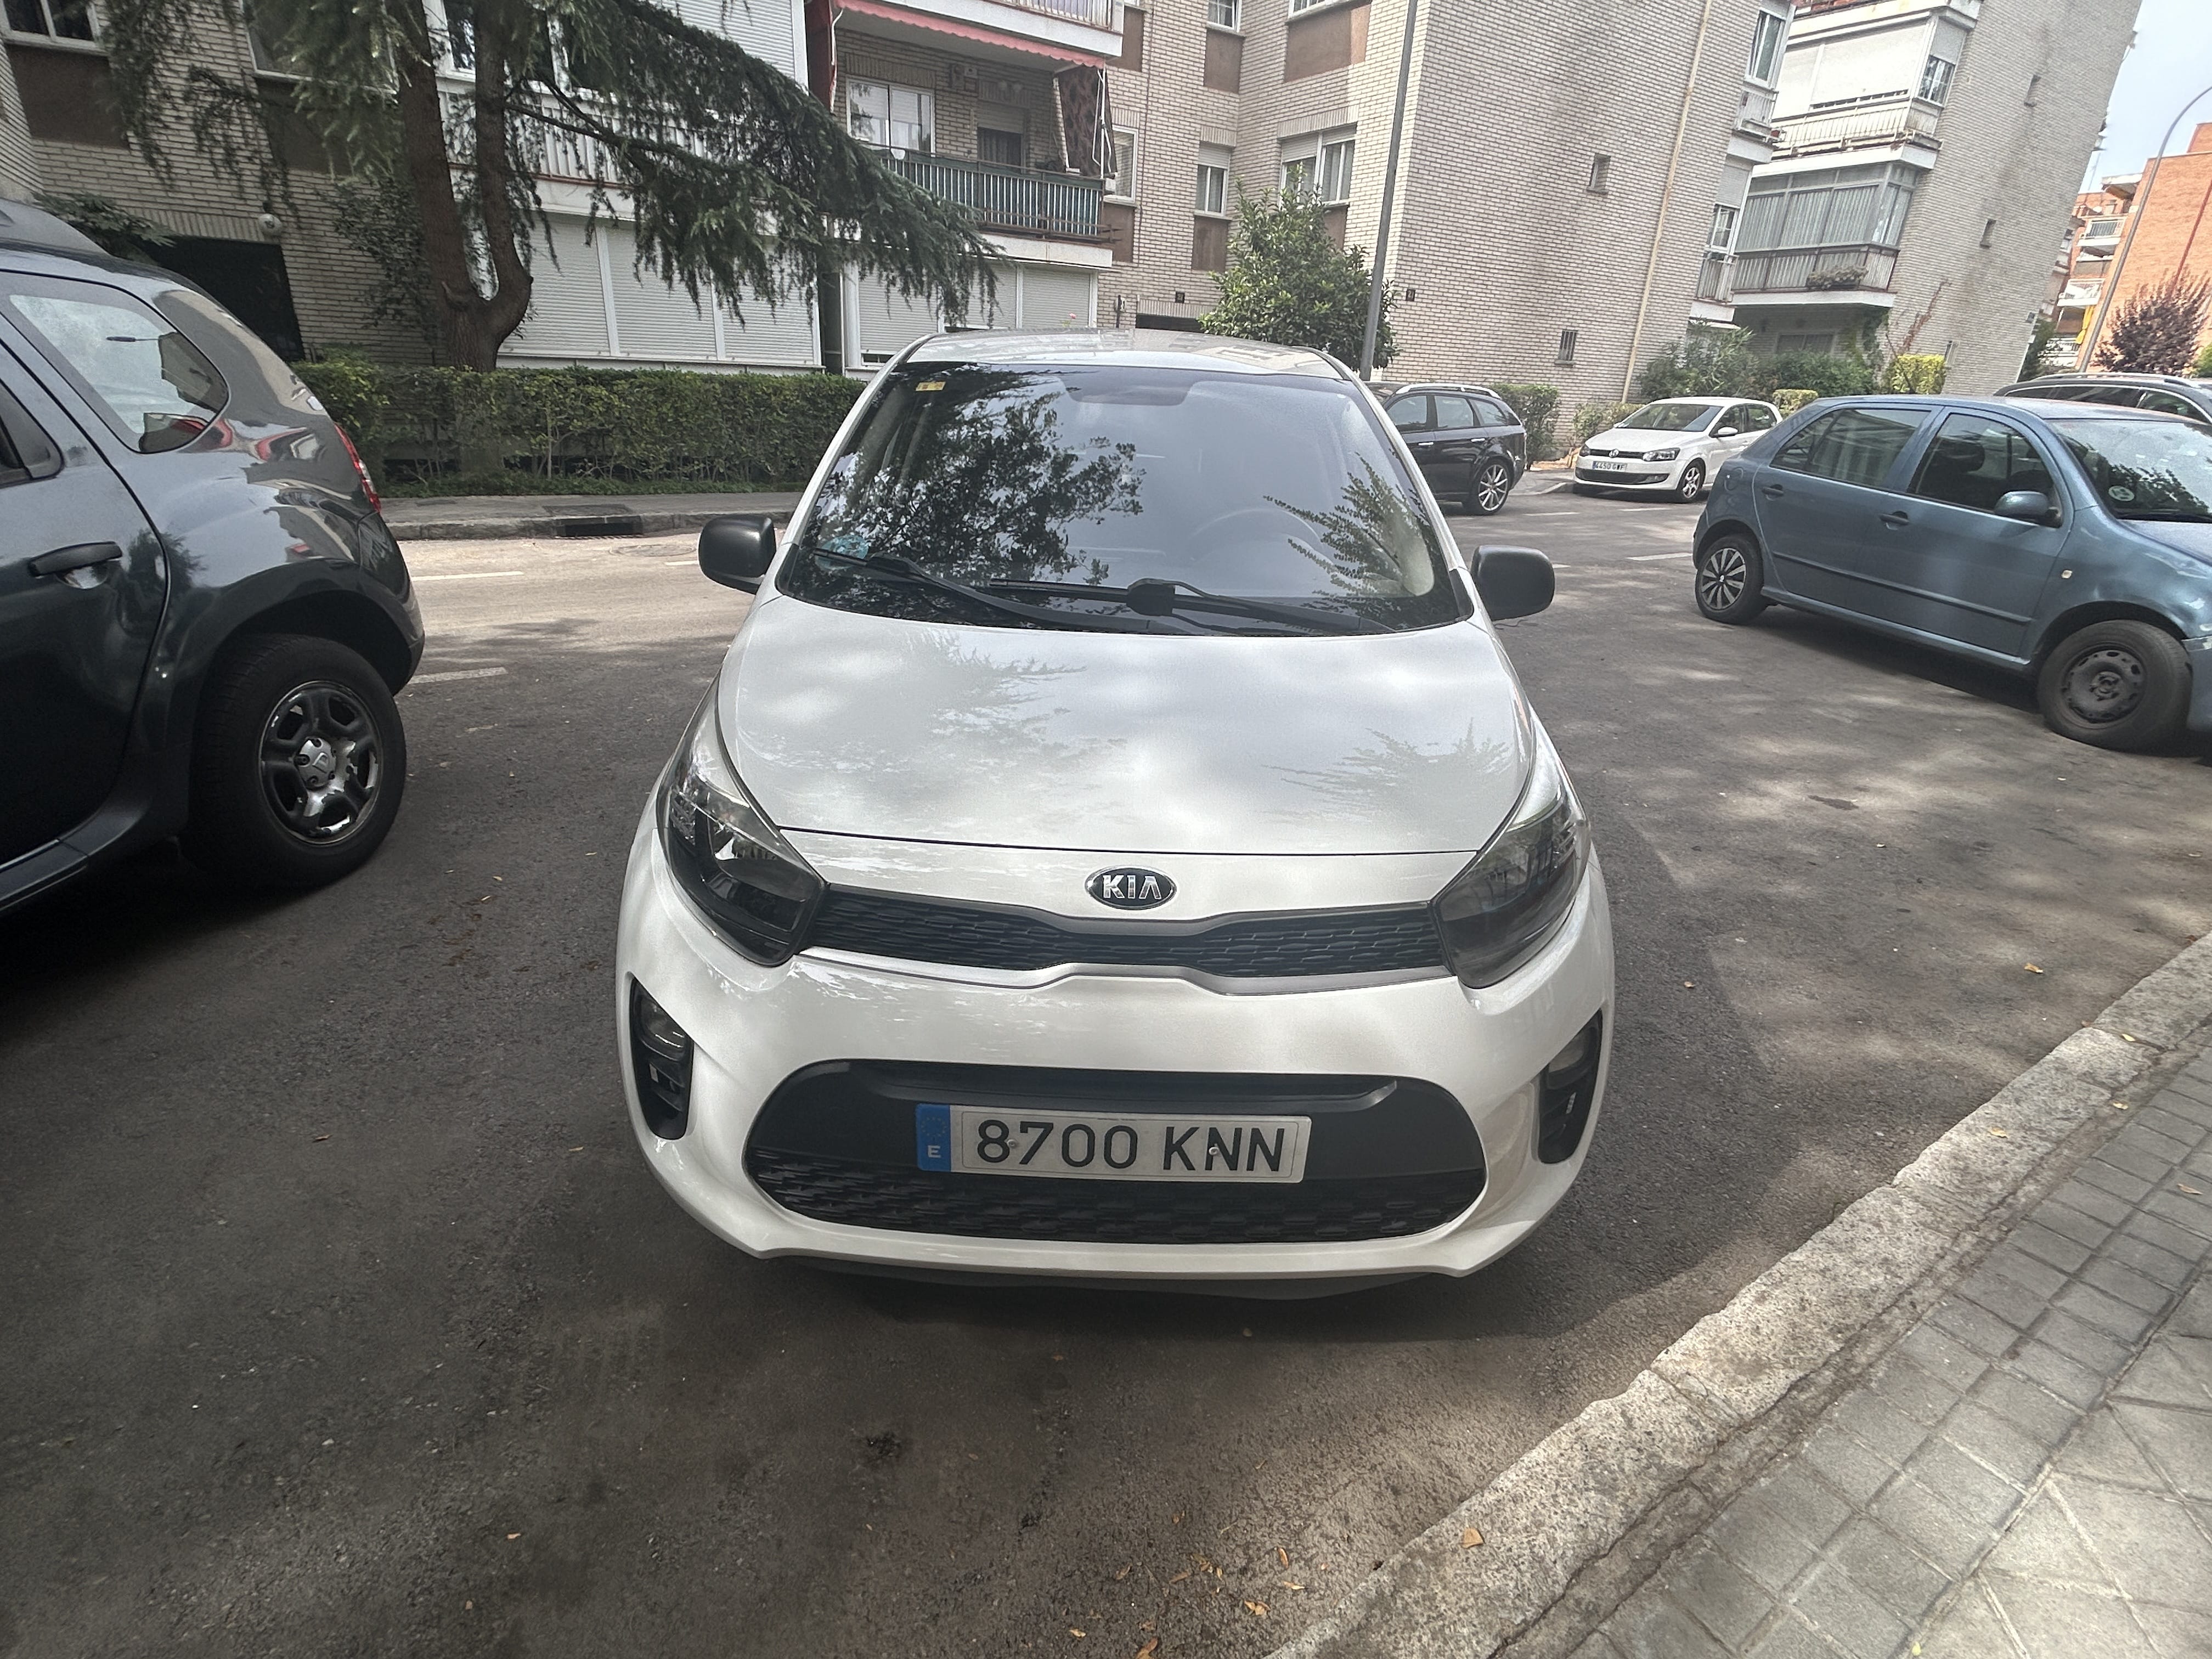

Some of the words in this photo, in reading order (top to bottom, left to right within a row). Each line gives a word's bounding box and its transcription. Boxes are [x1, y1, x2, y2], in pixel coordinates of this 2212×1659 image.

[1103, 874, 1162, 900] KIA
[928, 1145, 941, 1158] E
[977, 1120, 1138, 1169] 8700
[1163, 1126, 1285, 1172] KNN
